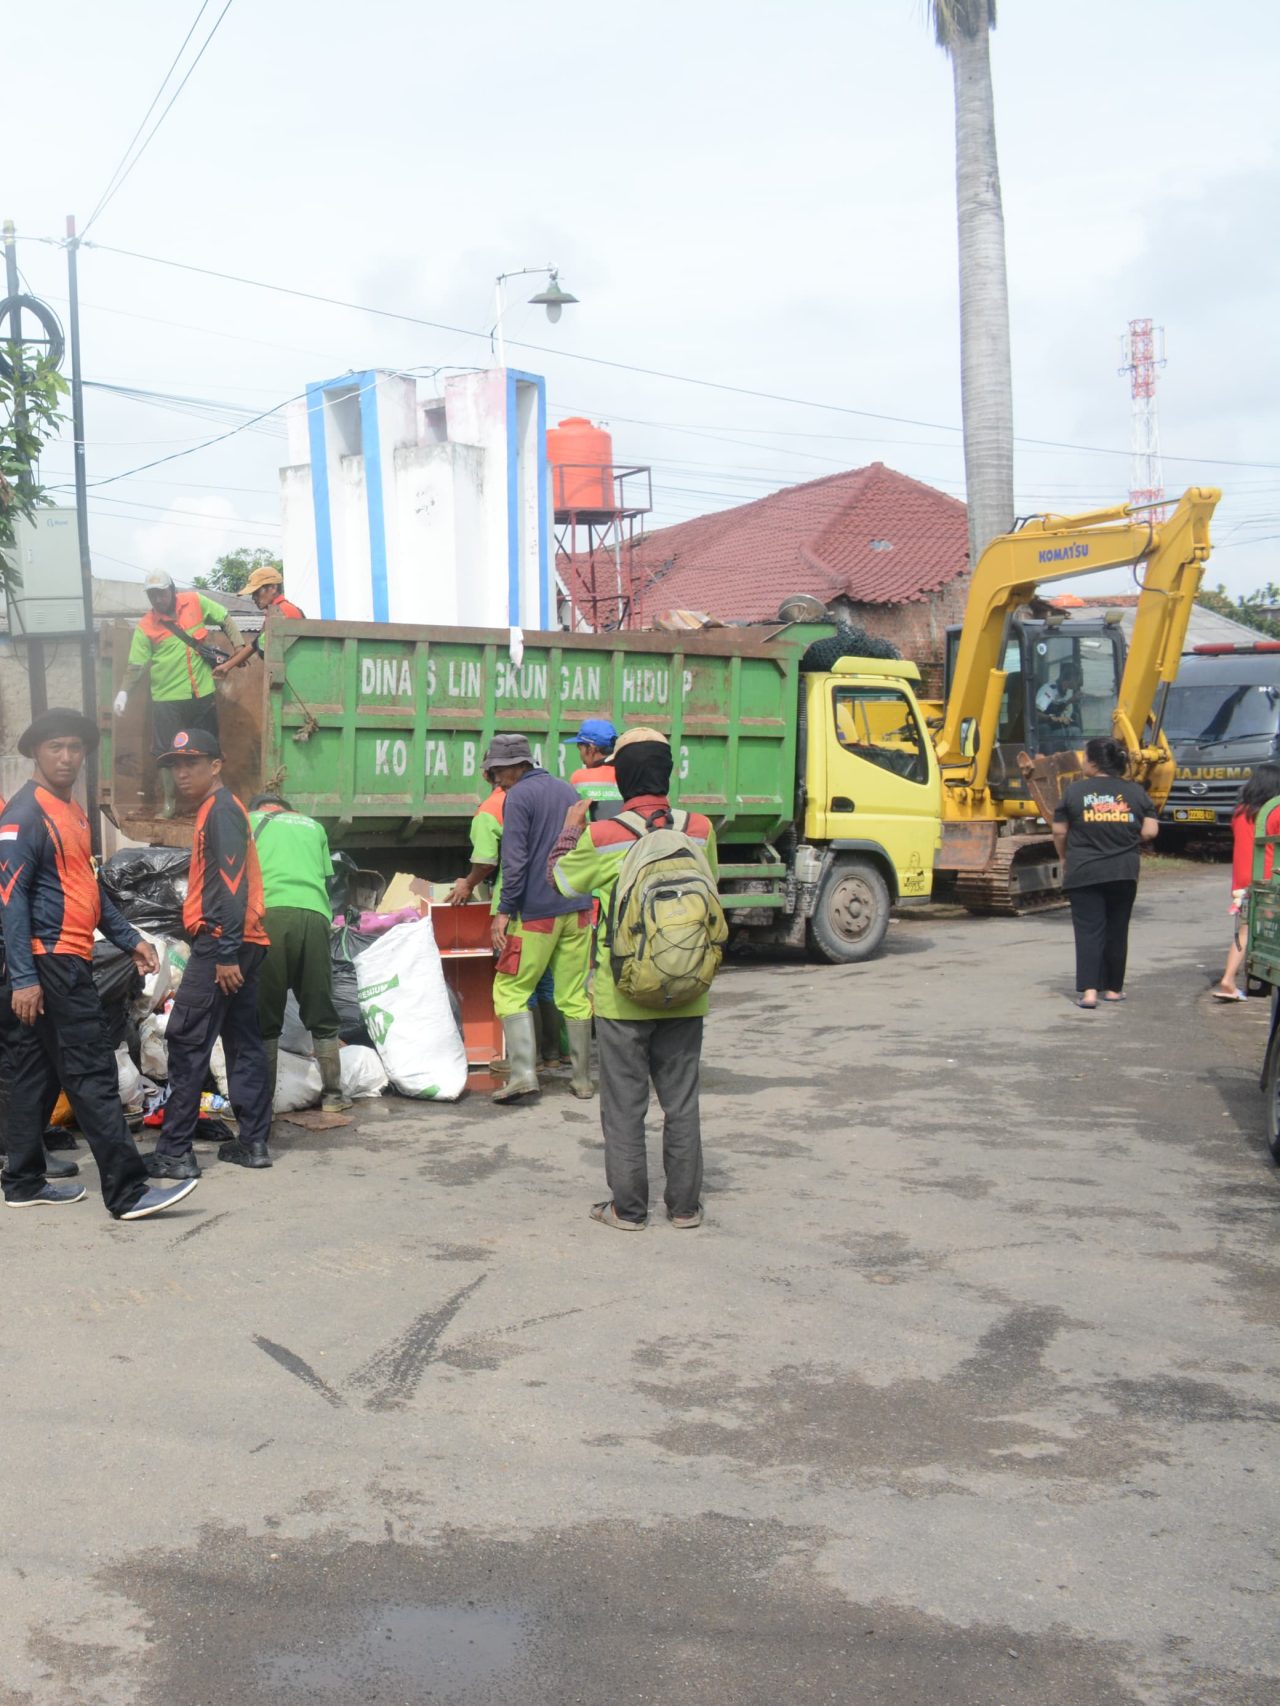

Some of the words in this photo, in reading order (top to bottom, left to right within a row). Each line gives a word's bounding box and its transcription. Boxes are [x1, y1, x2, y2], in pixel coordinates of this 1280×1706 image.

[1039, 541, 1089, 564] KOMATSU
[361, 657, 437, 697] DINAS
[448, 661, 601, 701] LINGKUNGAN
[622, 668, 694, 704] HIDUP
[375, 738, 449, 777] KOTA
[1083, 808, 1129, 823] Honda
